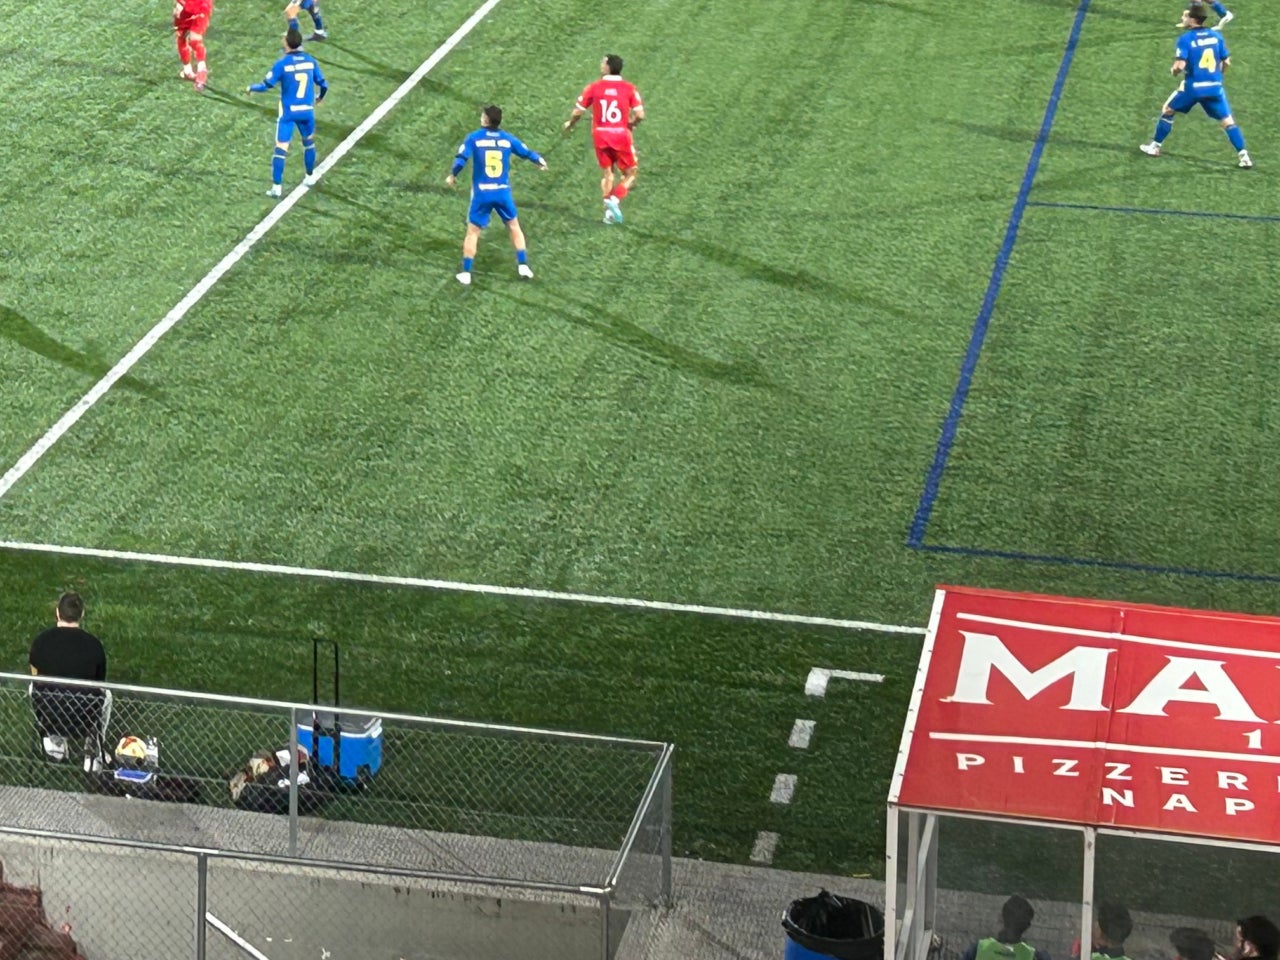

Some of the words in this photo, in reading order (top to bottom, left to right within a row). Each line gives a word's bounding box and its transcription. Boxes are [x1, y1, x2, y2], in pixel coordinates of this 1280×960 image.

[1198, 47, 1217, 74] 4
[294, 72, 308, 98] 7
[599, 99, 622, 123] 16
[939, 630, 1280, 725] MA
[956, 752, 1280, 793] PIZZER
